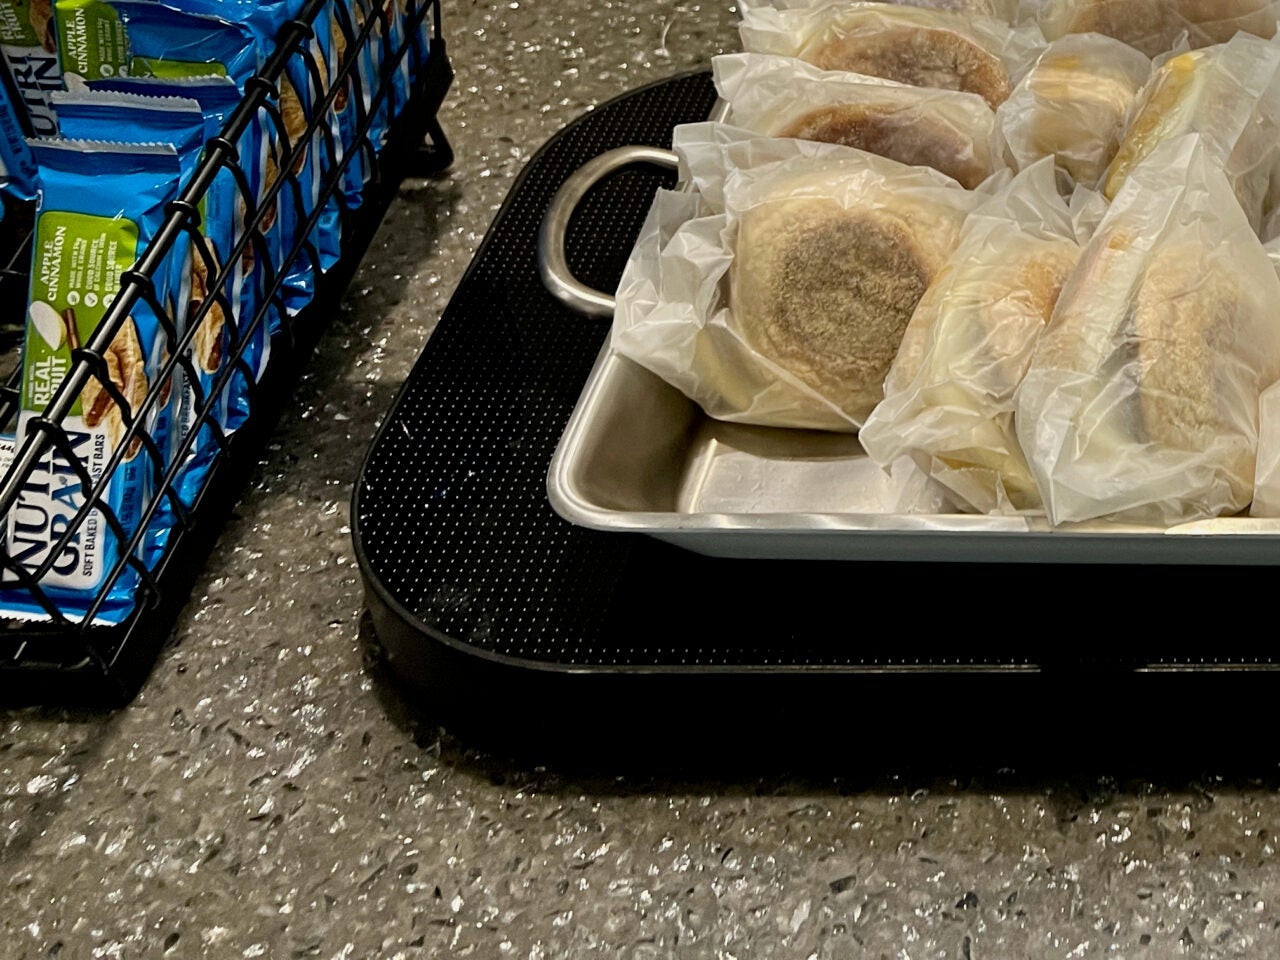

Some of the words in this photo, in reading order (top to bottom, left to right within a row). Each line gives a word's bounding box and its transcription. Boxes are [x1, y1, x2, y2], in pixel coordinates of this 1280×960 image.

[5, 1, 26, 40] FRUIT
[65, 19, 78, 59] APPLE
[75, 6, 89, 74] CINNAMON
[7, 54, 57, 137] UTRI
[40, 240, 54, 285] APPLE
[47, 226, 67, 302] CINNAMON
[34, 355, 52, 405] REAL
[49, 355, 67, 400] RUIT
[92, 434, 105, 460] BARS
[50, 430, 91, 576] GRAIN
[84, 518, 98, 551] BAKED
[83, 553, 95, 577] SOFT
